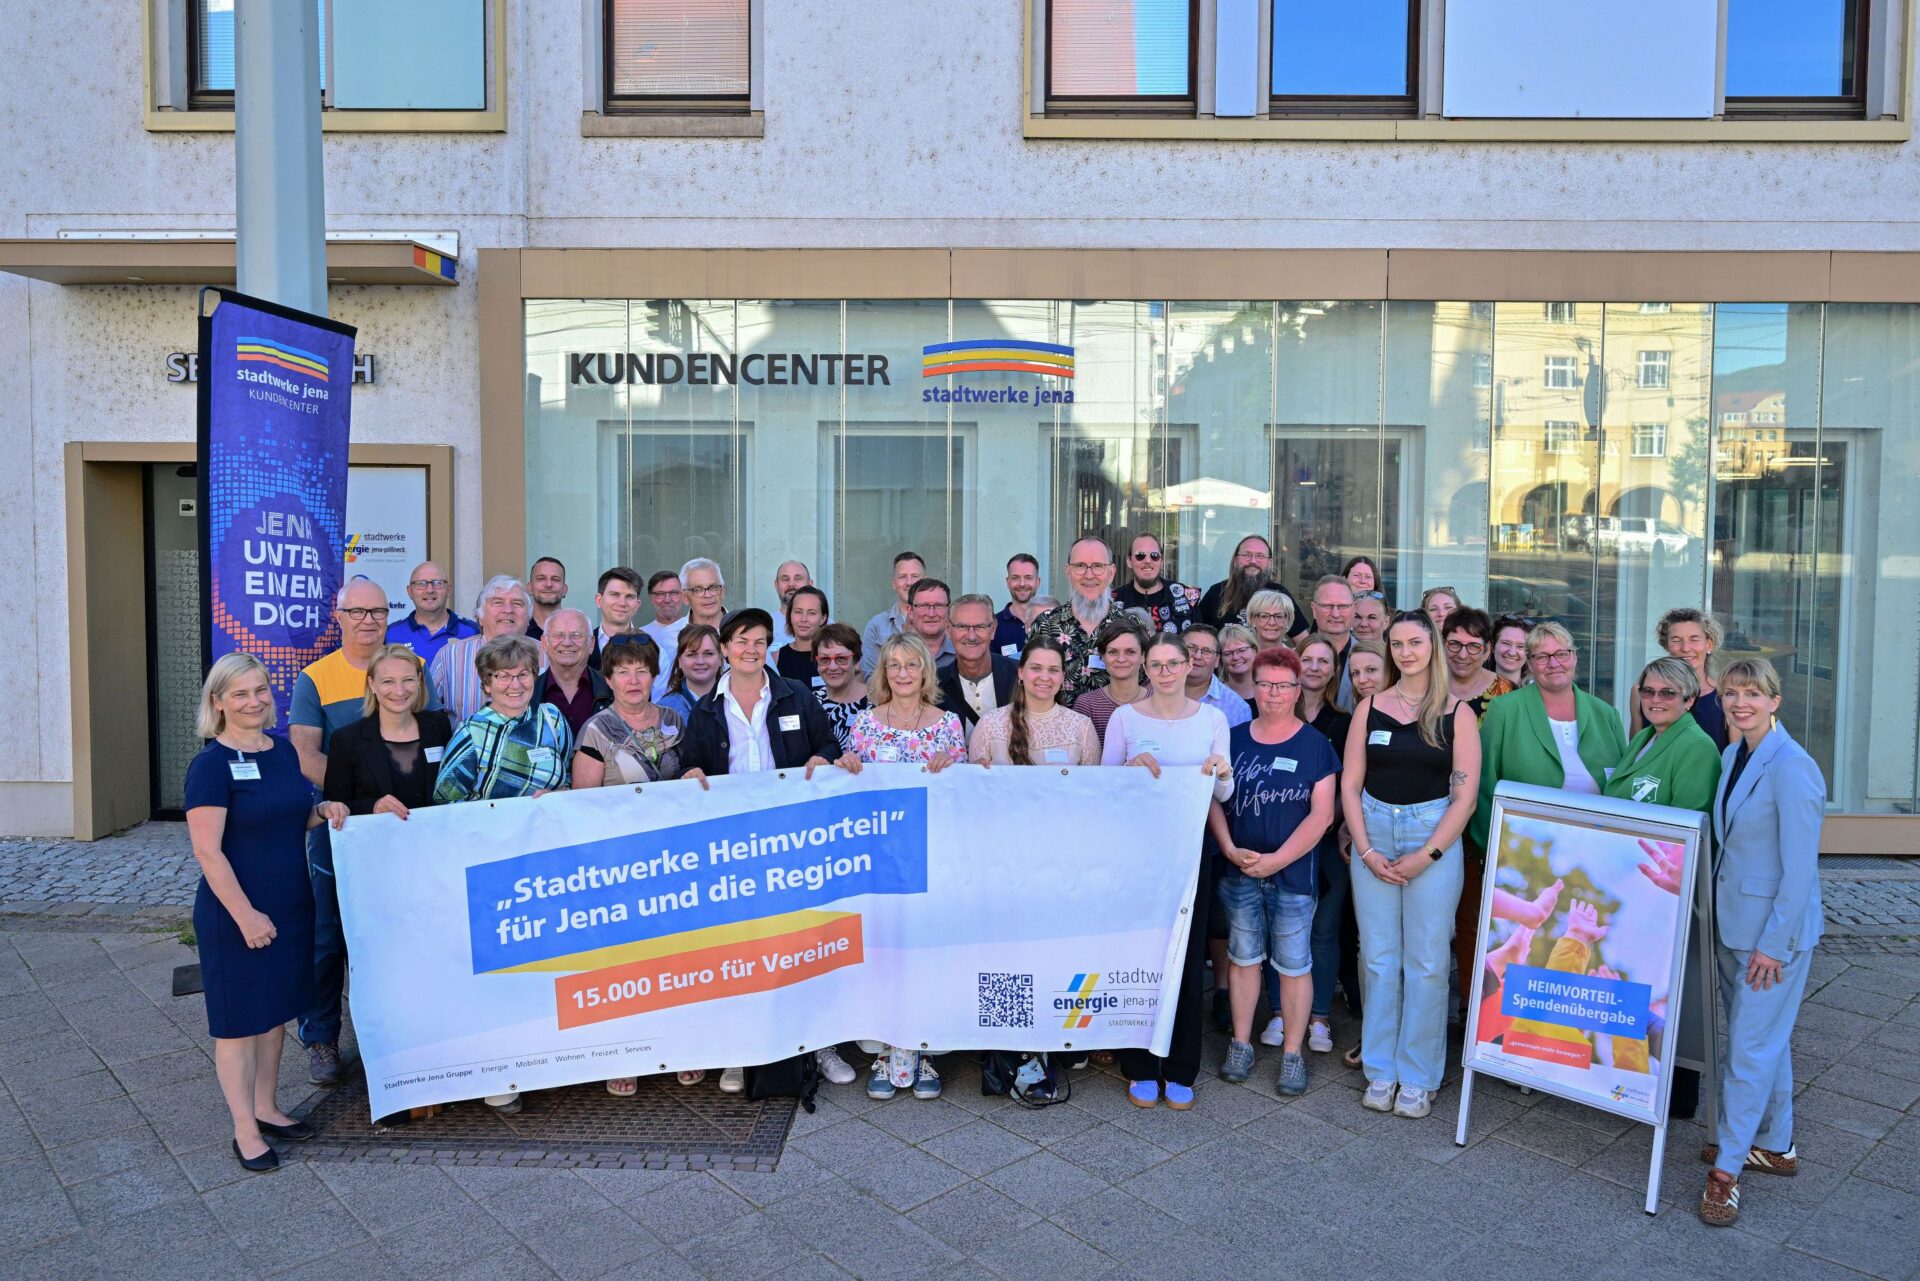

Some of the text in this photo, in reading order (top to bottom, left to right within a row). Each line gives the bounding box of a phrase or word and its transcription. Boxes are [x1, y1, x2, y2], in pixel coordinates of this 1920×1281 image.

[236, 368, 329, 400] stadtwerke jena
[570, 352, 891, 386] KUNDENCENTER
[249, 388, 320, 415] KUNDENCENTER
[922, 385, 1075, 405] stadtwerke jena
[255, 510, 313, 541] JENA
[363, 533, 406, 541] stadtwerke
[243, 539, 322, 571] UNTER
[344, 545, 370, 555] nergie
[245, 571, 323, 600] EINEM
[496, 853, 872, 945] für Jena und die Region
[571, 935, 850, 1009] 15.000 Euro für Vereine
[1053, 992, 1118, 1013] energie
[1527, 979, 1623, 1006] HEIMVORTEIL-
[1108, 1019, 1148, 1027] STADTWERKE
[1512, 993, 1636, 1026] Spendenübergabe
[384, 1044, 652, 1091] Stadtwerke Jena Gruppe Energie Mobilität Wohnen Freizeit Services
